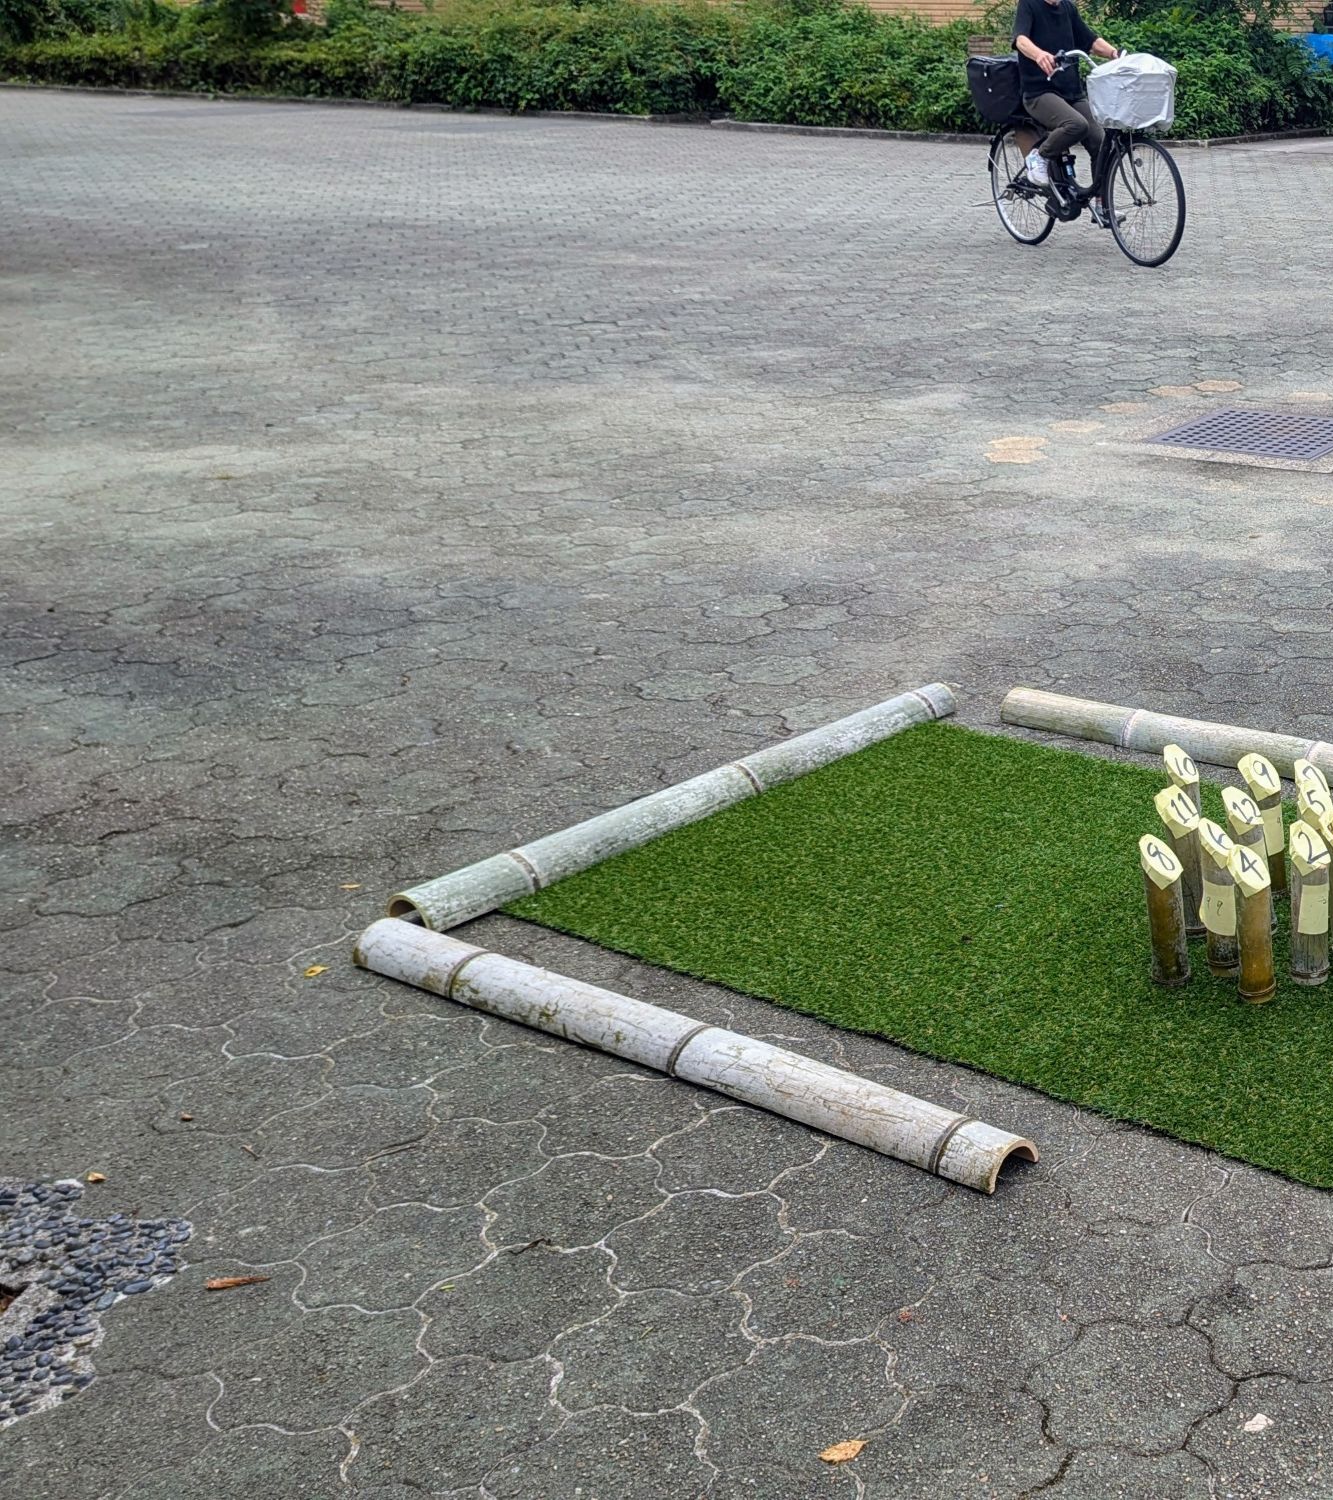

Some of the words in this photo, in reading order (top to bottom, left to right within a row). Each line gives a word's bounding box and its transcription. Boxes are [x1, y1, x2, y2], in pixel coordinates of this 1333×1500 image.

[1175, 757, 1197, 776] 10
[1252, 760, 1276, 788] 9
[1302, 765, 1328, 793] 7
[1170, 792, 1198, 824] 11
[1232, 798, 1262, 825] 12
[1306, 789, 1326, 814] 5
[1146, 842, 1175, 871] 8
[1297, 831, 1329, 864] 2
[1239, 849, 1264, 881] 4
